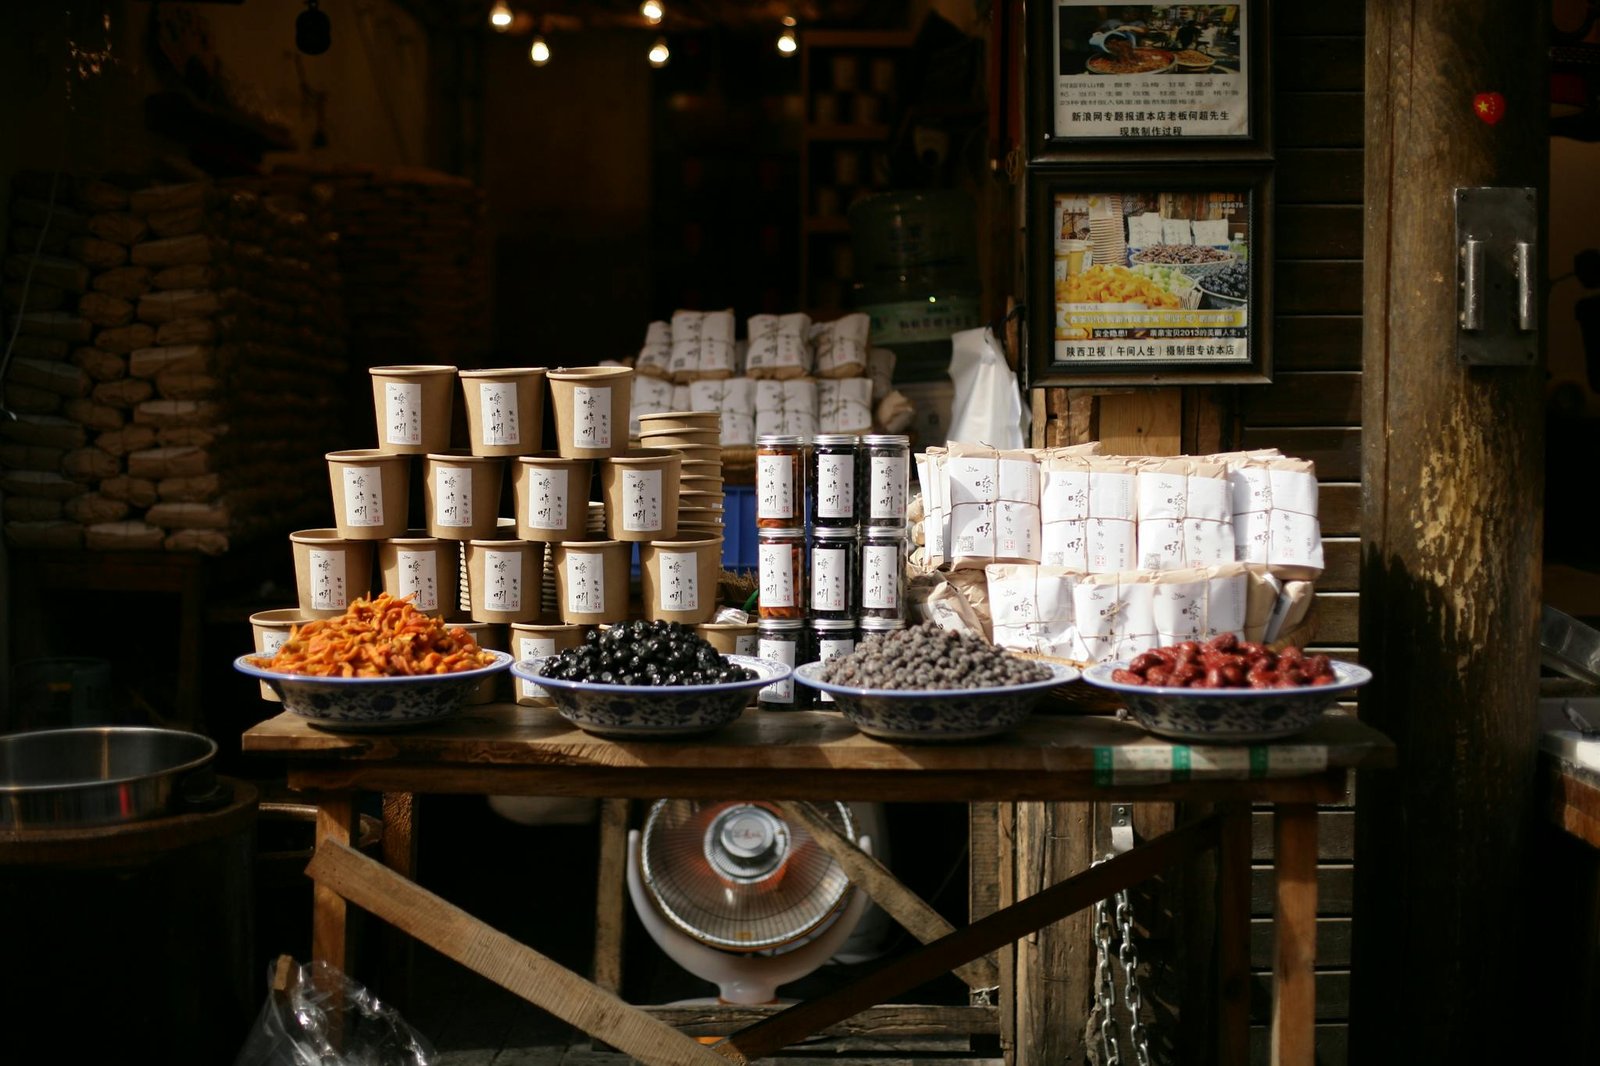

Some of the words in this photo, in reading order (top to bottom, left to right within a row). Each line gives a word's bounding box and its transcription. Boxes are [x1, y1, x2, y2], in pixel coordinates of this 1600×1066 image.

[1071, 111, 1230, 122] 新浪网专题报道本店老板何超先生
[1119, 126, 1183, 136] 现熬制作过程
